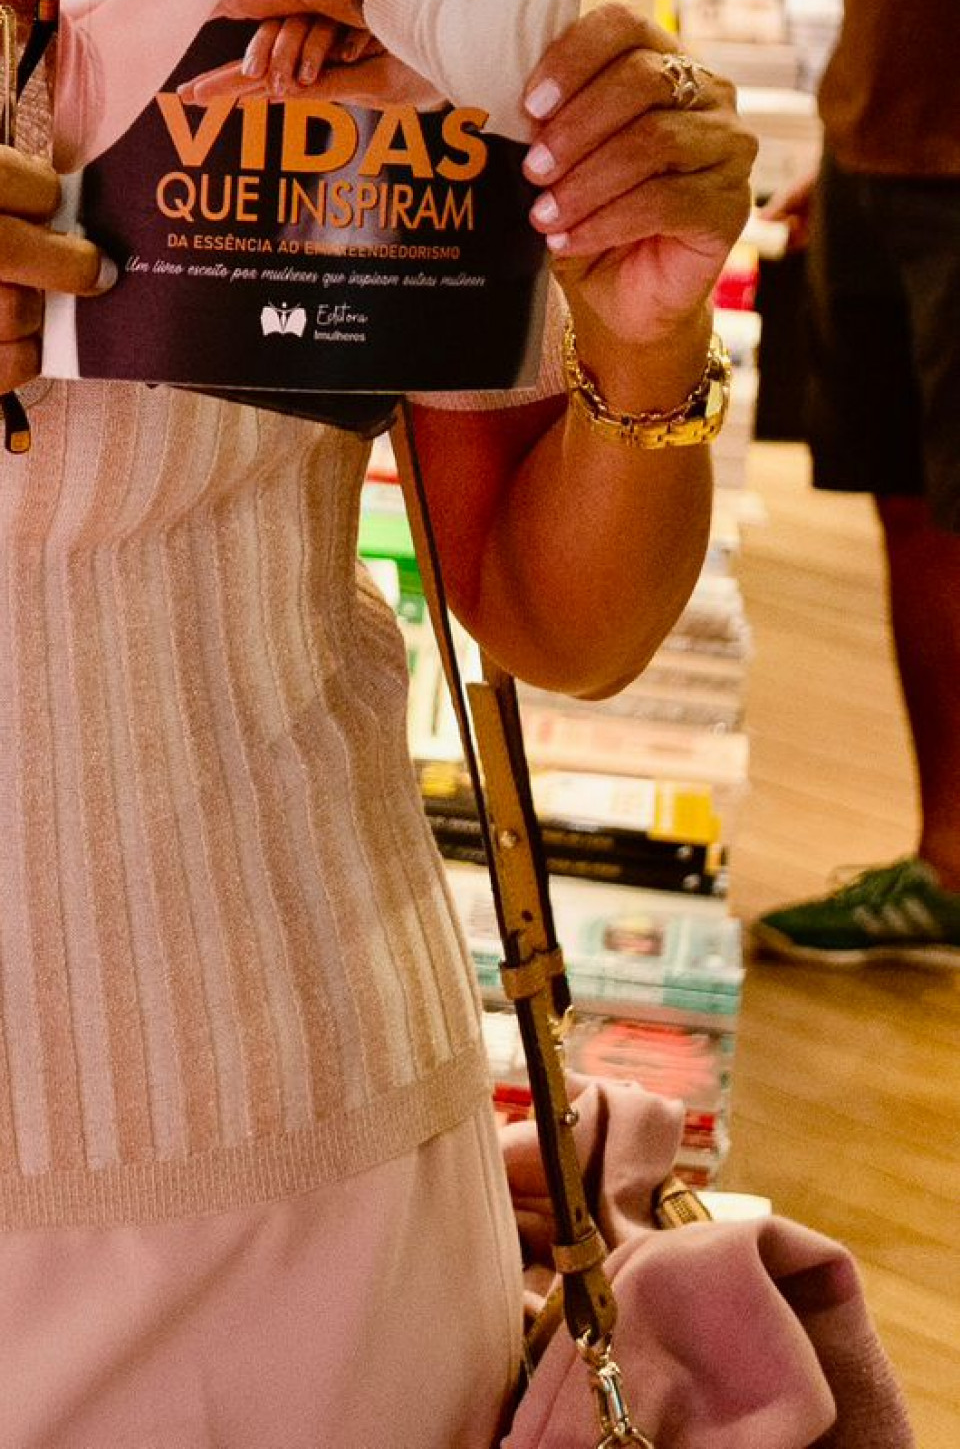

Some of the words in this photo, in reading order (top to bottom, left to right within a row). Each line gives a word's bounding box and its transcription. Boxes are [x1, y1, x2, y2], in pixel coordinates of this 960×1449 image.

[154, 91, 489, 182] VIDAS
[155, 171, 260, 222] QUE
[277, 176, 474, 231] INSPIRAM
[167, 233, 188, 248] DA
[193, 233, 272, 252] ESSÊNCIA
[278, 239, 300, 255] AO
[125, 255, 149, 272] Um
[152, 258, 183, 274] livro
[187, 262, 231, 277] escrito
[230, 267, 258, 283] por
[261, 265, 318, 282] mulheres
[322, 271, 345, 288] que
[317, 303, 369, 326] Editora
